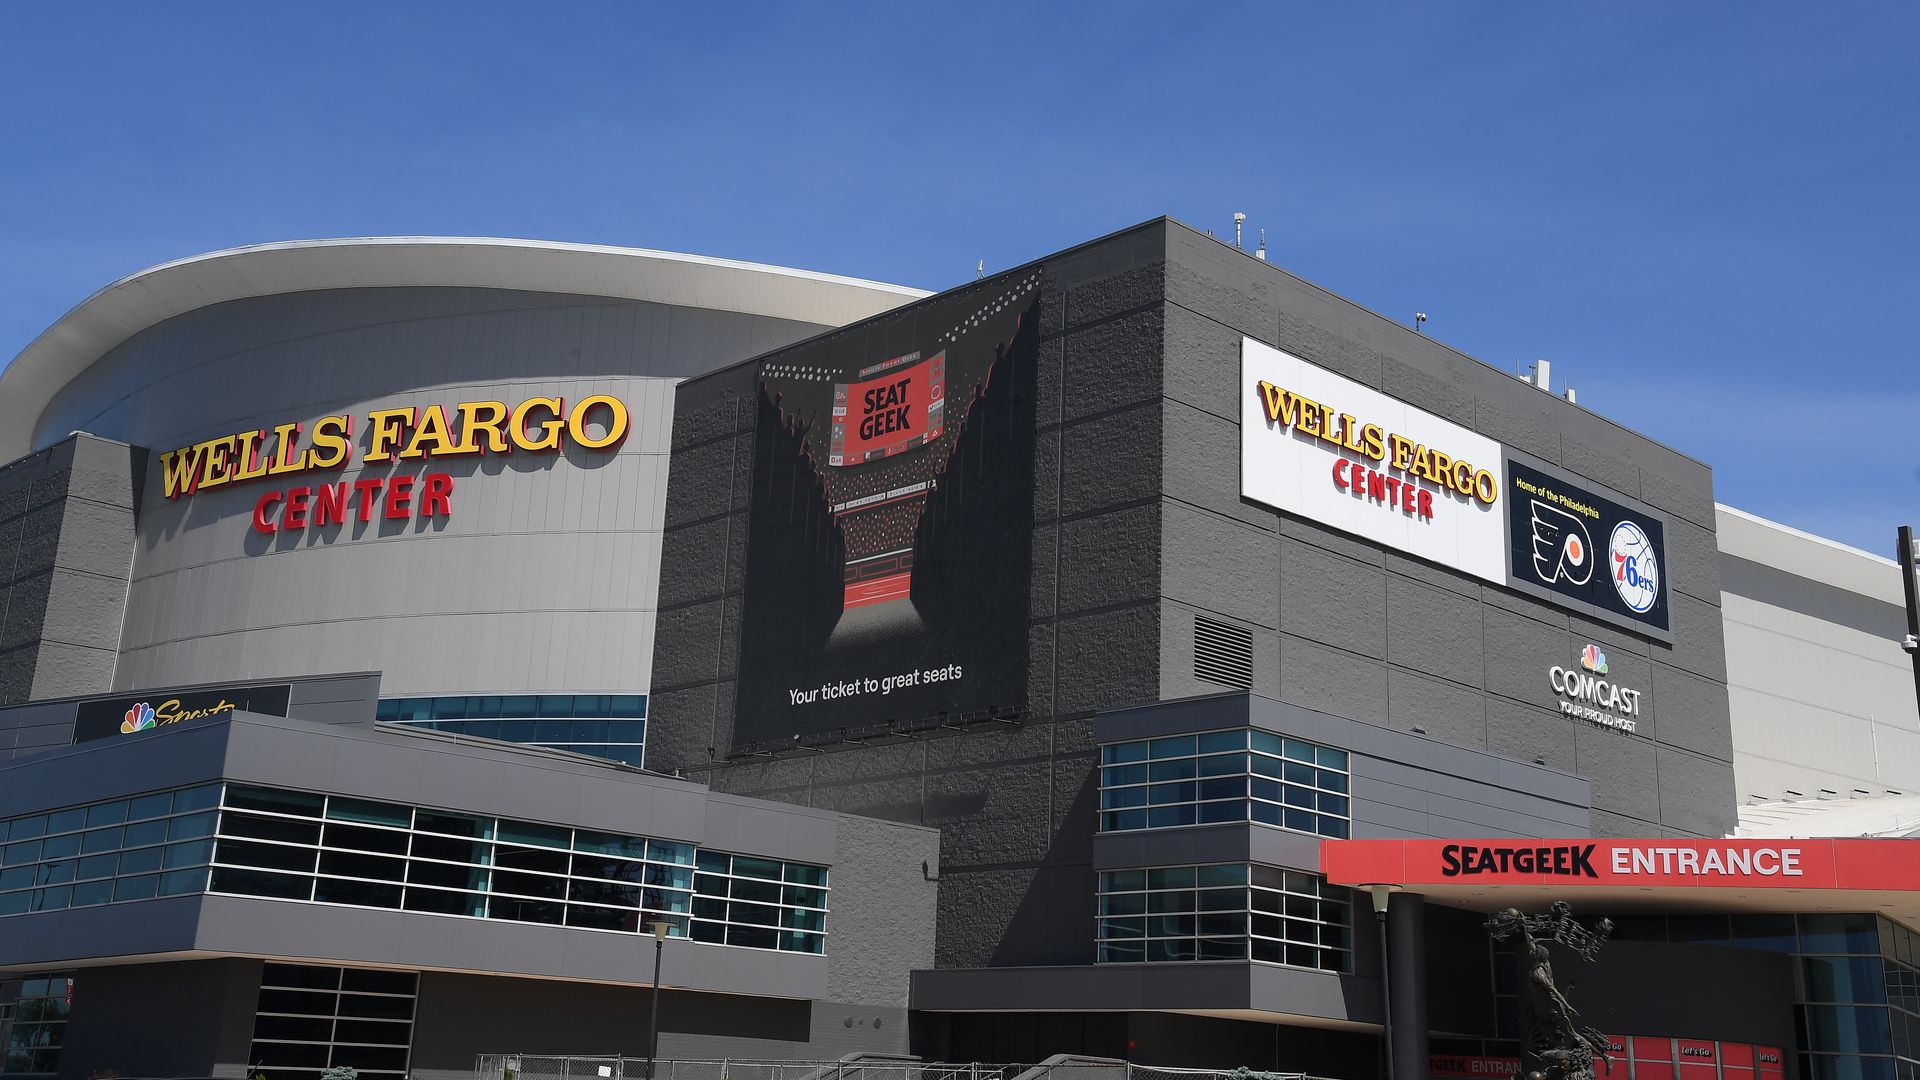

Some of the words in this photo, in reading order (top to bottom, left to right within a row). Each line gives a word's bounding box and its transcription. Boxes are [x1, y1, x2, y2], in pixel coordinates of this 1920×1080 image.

[864, 378, 911, 414] SEAT
[860, 404, 911, 441] GEEK
[1257, 380, 1386, 462] WELLS
[1388, 433, 1497, 504] FARGO
[160, 414, 353, 500] WELLS
[363, 395, 631, 463] FARGO
[253, 473, 453, 534] CENTER
[1333, 458, 1434, 519] CENTER
[1516, 477, 1537, 494] Home
[1537, 487, 1546, 497] of
[1546, 489, 1559, 503] the
[1559, 494, 1600, 519] Philadelphia
[790, 688, 819, 705] Your
[821, 679, 861, 700] ticket
[864, 677, 879, 693] to
[881, 669, 920, 695] great
[923, 664, 963, 684] seats
[1549, 666, 1640, 716] COMCAST
[1560, 701, 1583, 716] YOUR
[1585, 708, 1614, 725] PROUD
[1614, 717, 1636, 732] HOST
[1442, 844, 1598, 878] SEATGEEK
[1611, 847, 1804, 876] ENTRANCE
[1681, 1046, 1698, 1055] Let's
[1700, 1048, 1710, 1056] Go
